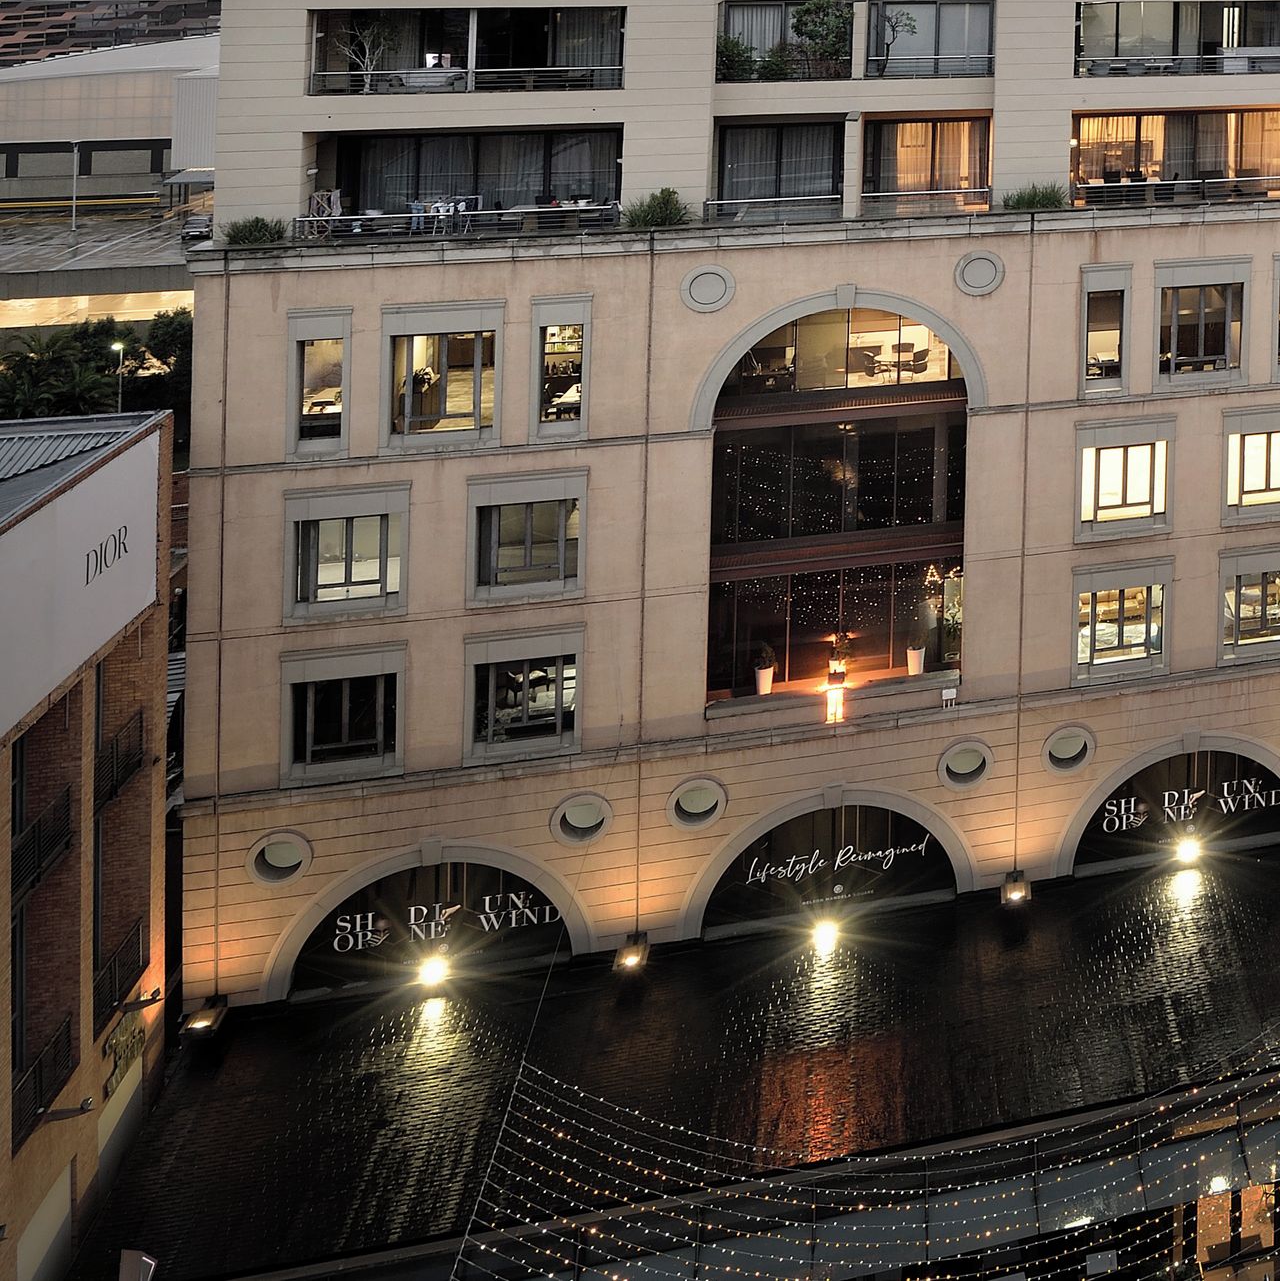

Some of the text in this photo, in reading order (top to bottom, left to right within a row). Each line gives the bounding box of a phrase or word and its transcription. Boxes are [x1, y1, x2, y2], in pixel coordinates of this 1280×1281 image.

[85, 525, 130, 587] DIOR
[746, 833, 931, 885] Lifestyle Reimagined
